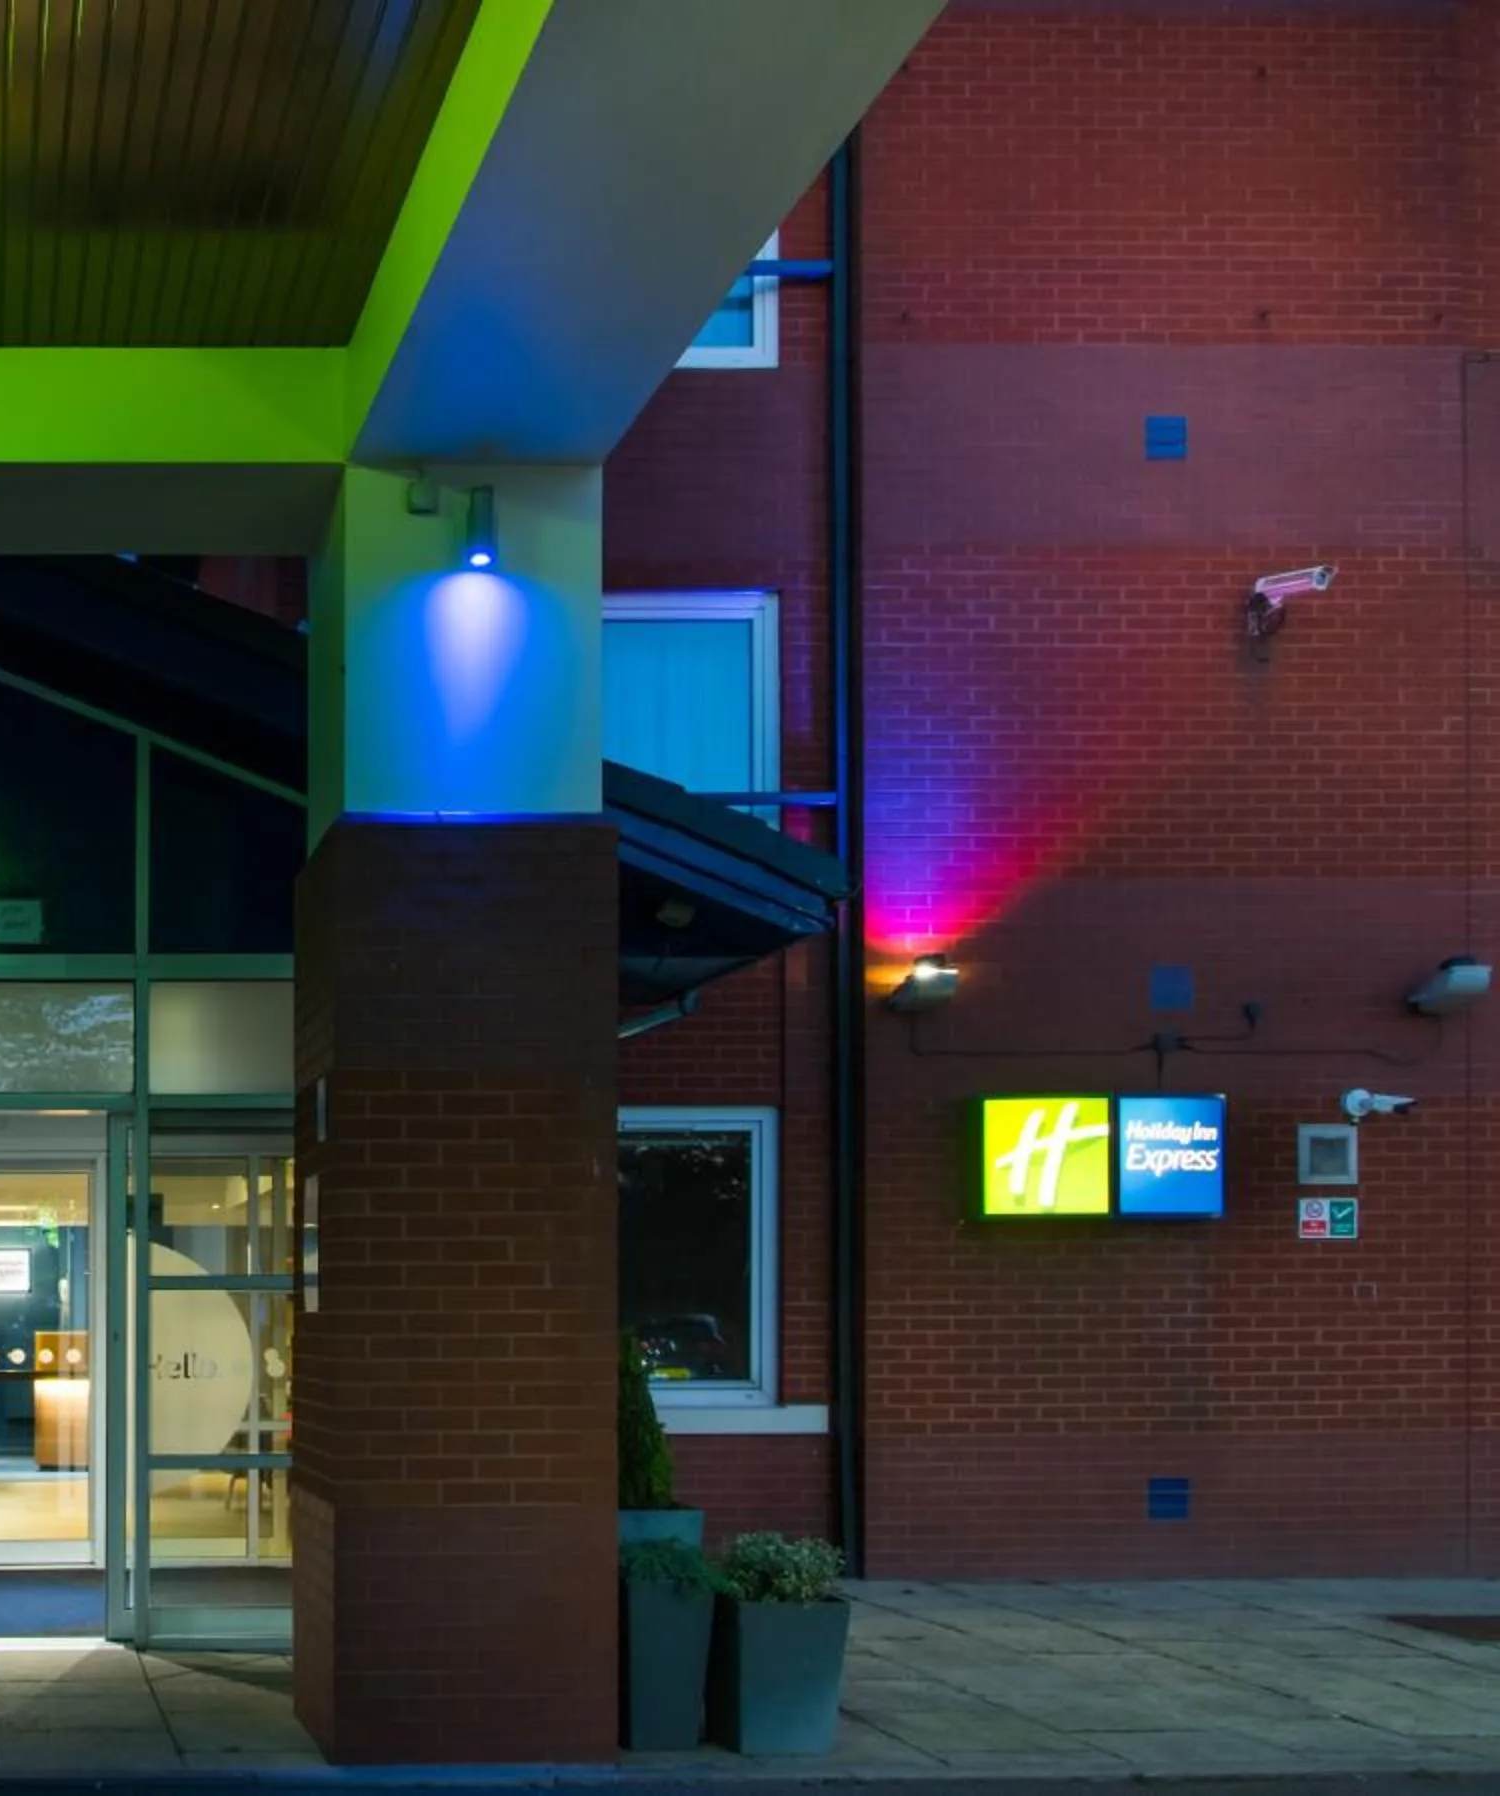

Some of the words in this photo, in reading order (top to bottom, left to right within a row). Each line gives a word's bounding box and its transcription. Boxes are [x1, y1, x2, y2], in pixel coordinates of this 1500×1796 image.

[1125, 1120, 1192, 1145] Holiday
[1192, 1120, 1218, 1141] Inn
[995, 1102, 1109, 1207] H
[1125, 1143, 1220, 1177] Express
